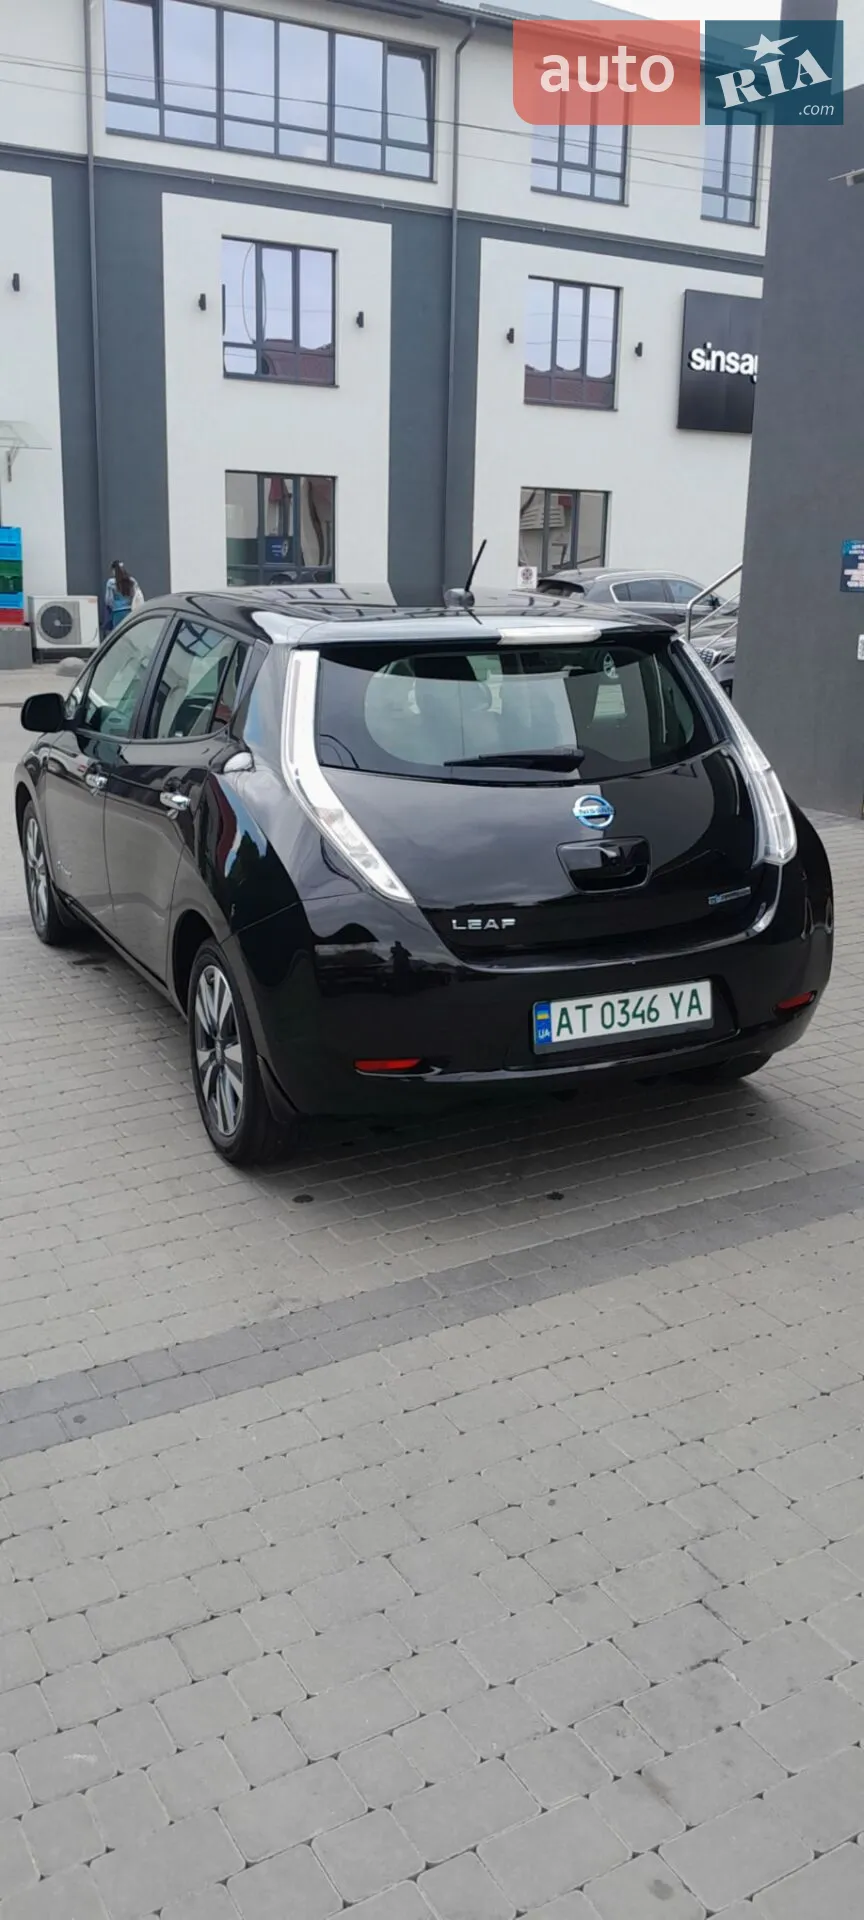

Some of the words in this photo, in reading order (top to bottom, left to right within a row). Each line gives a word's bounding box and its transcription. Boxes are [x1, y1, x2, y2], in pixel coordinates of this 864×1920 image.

[451, 918, 516, 930] LEAF
[556, 1004, 593, 1036] AT
[600, 994, 660, 1030] 0346
[669, 988, 703, 1018] YA
[538, 1030, 550, 1039] UA
